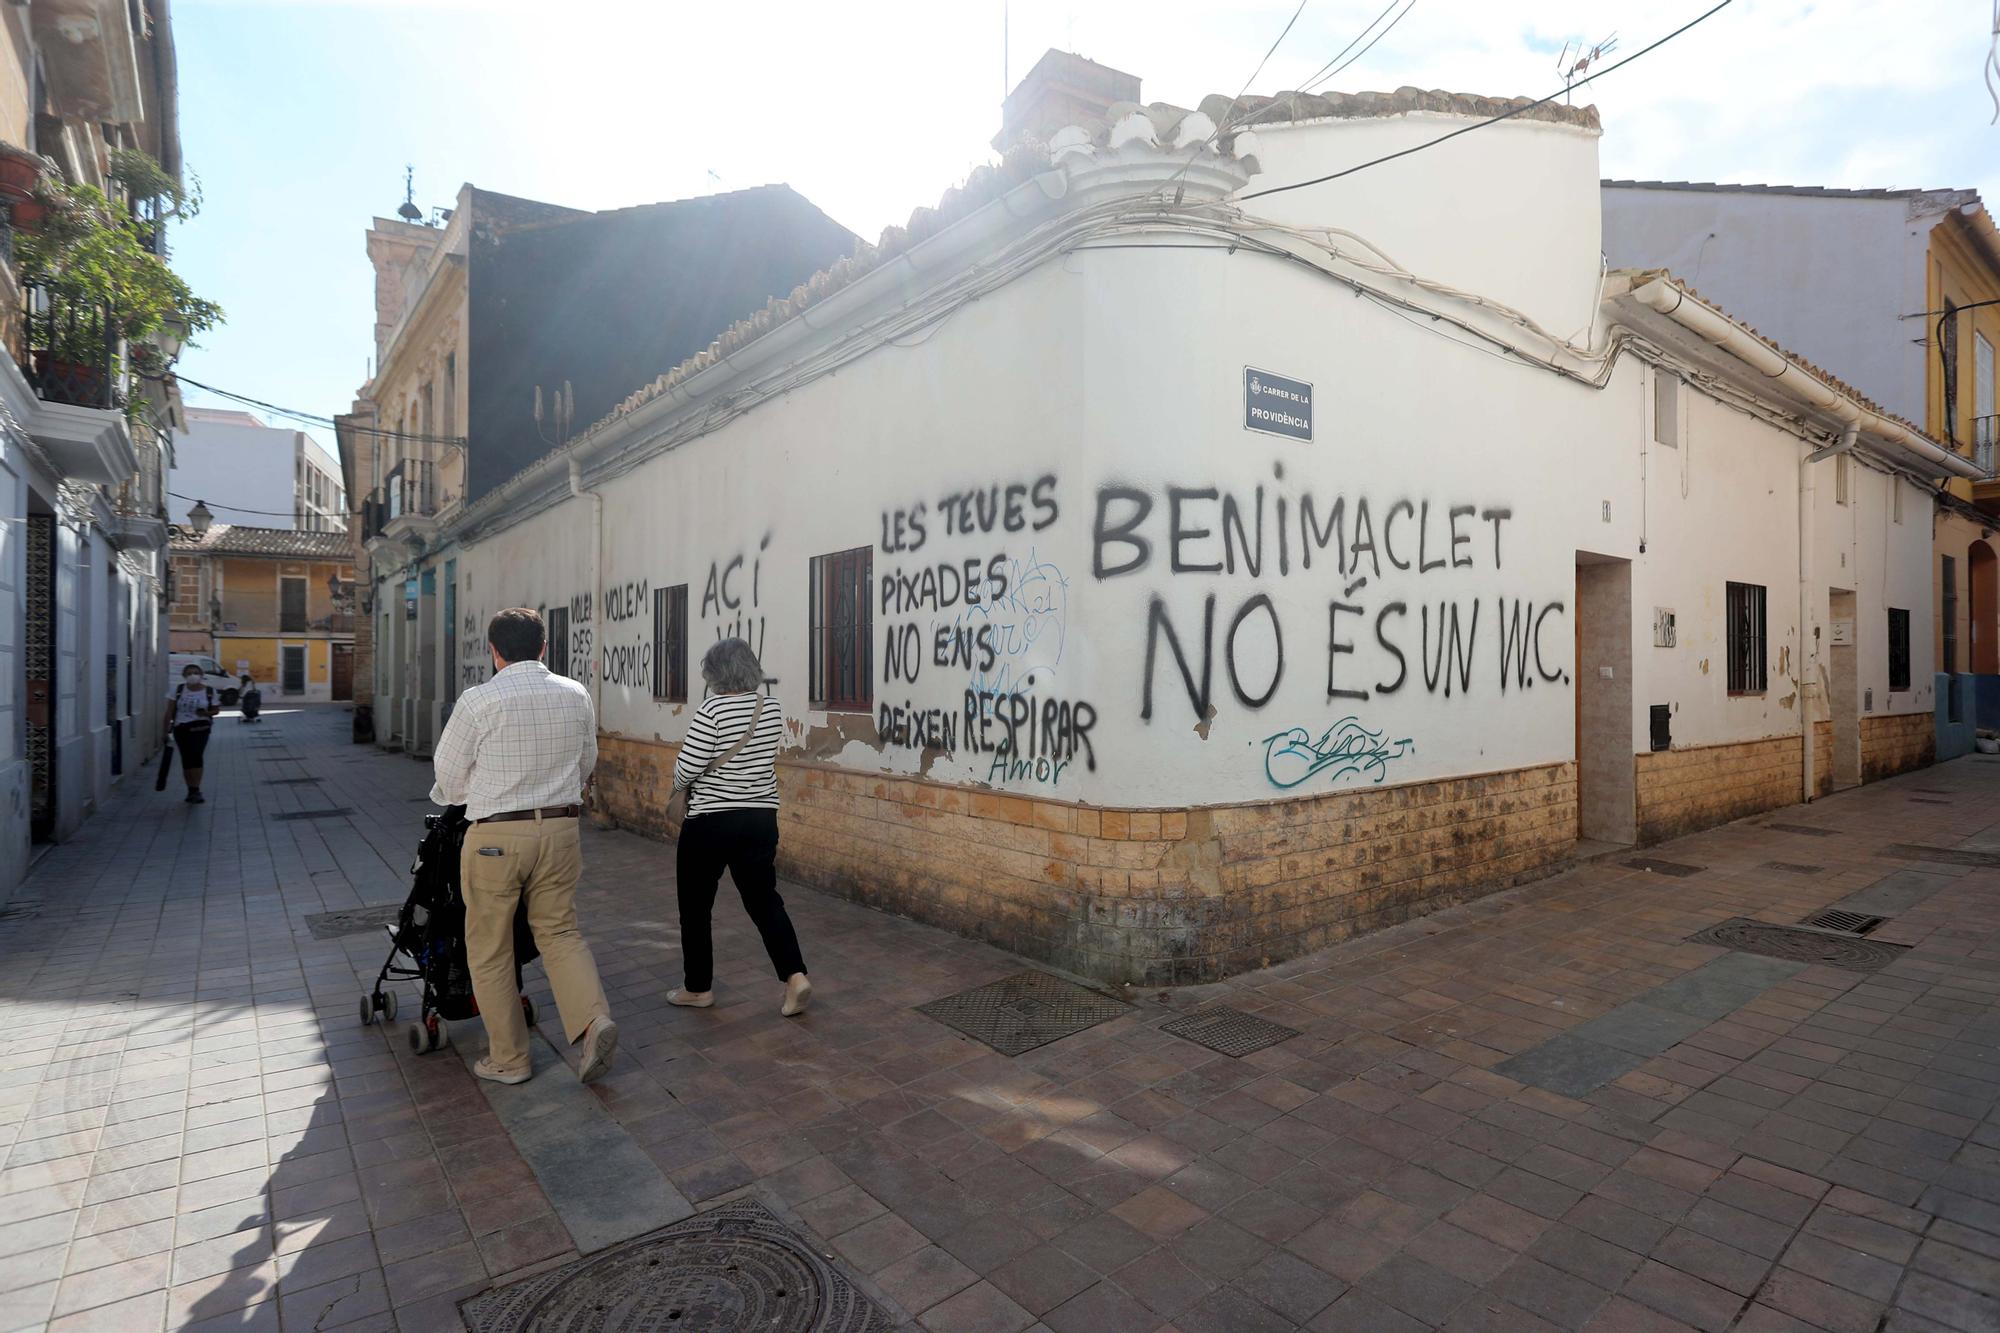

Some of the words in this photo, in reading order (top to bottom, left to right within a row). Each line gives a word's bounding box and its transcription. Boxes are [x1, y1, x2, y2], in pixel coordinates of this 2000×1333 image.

[1251, 407, 1309, 430] PROVIDÈNCIA
[1263, 385, 1289, 399] CARRER
[1290, 392, 1300, 402] DE
[1300, 395, 1309, 404] LA
[881, 502, 927, 553] LES
[937, 474, 1058, 535] TEUES
[605, 579, 648, 622] VOLEM
[884, 622, 921, 684] NO
[933, 624, 996, 672] ENS
[1141, 593, 1283, 723] NO
[1327, 575, 1408, 702] ÉS
[1421, 597, 1479, 697] UN
[1499, 596, 1570, 696] W.C.
